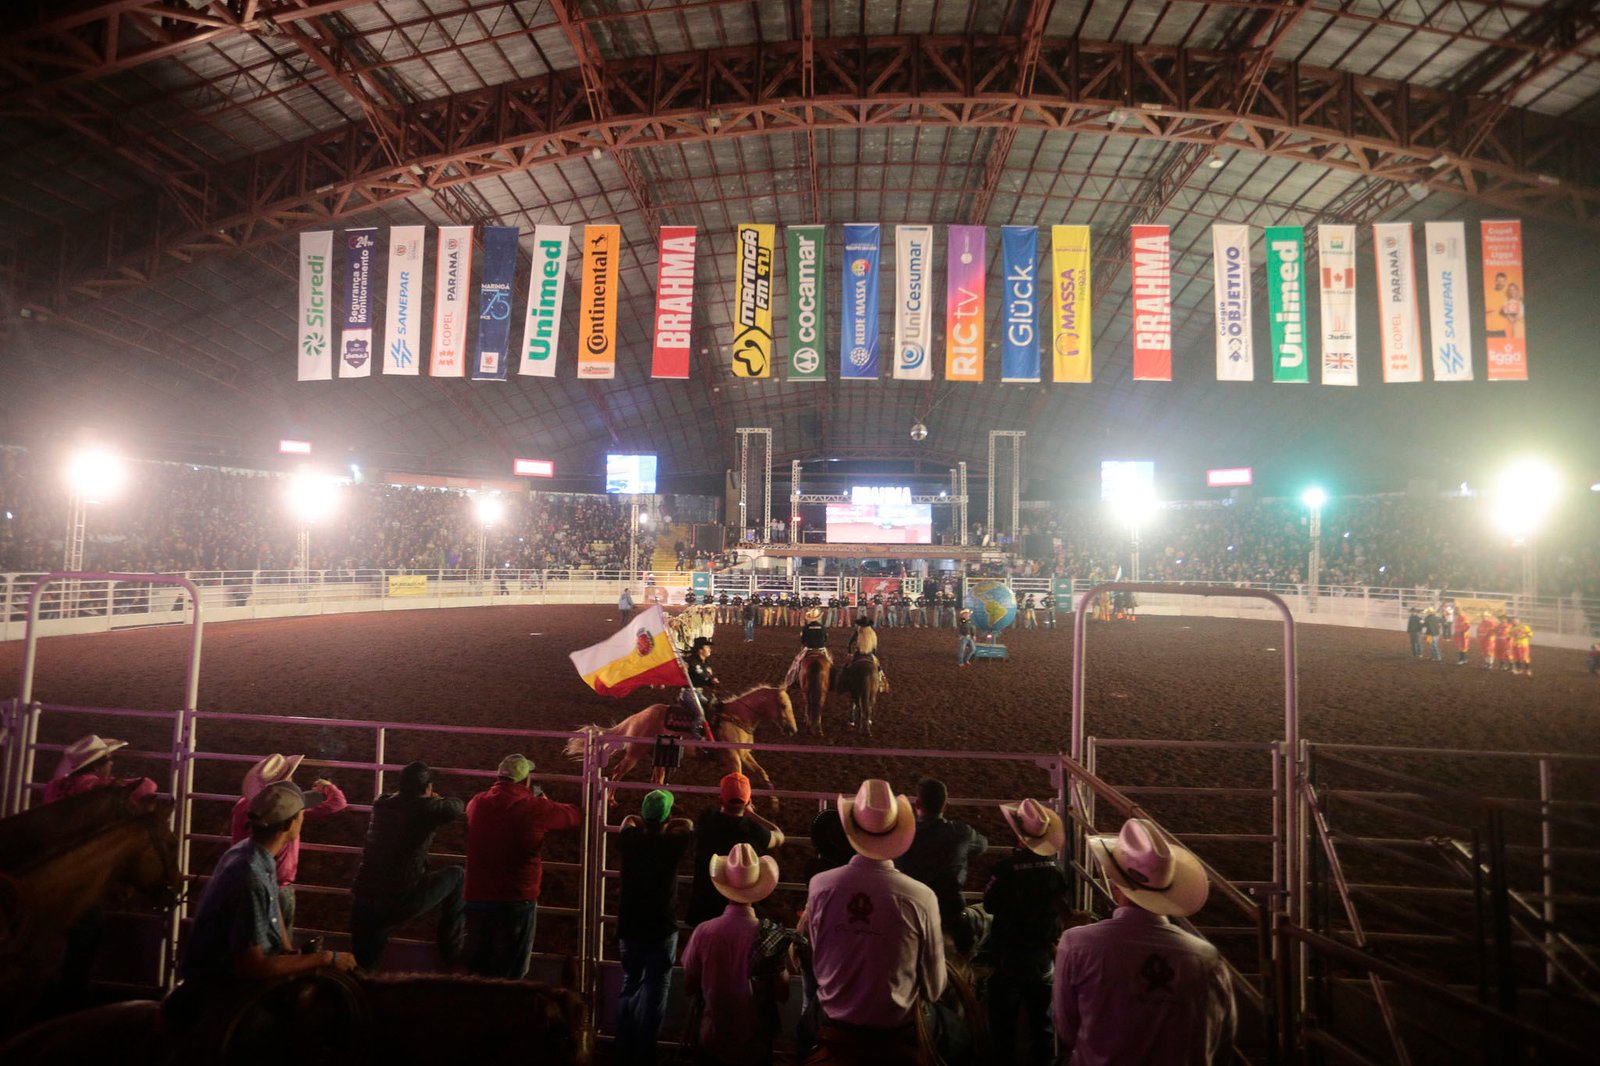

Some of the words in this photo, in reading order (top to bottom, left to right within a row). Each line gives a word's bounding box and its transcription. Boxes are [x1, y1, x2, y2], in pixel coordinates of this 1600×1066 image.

[307, 255, 324, 327] Sicredi
[350, 270, 360, 323] Segurança
[358, 250, 369, 323] Monitoramento
[398, 271, 410, 335] SANEPAR
[482, 289, 510, 320] 75
[528, 240, 562, 360] Unimed
[587, 251, 609, 354] Continental
[656, 235, 696, 349] BRAHMA
[757, 279, 769, 309] FM
[799, 236, 816, 342] cocamar
[856, 280, 866, 317] MASSA
[905, 240, 922, 339] UniCesumar
[1008, 264, 1033, 347] Glück
[1061, 268, 1075, 330] MASSA
[1135, 235, 1171, 350] BRAHMA
[1226, 246, 1242, 337] OBJETIVO
[1271, 241, 1303, 368] Unimed
[1441, 271, 1455, 338] SANEPAR
[443, 312, 453, 346] COPEL
[855, 318, 866, 345] REDE
[1392, 314, 1402, 350] COPEL
